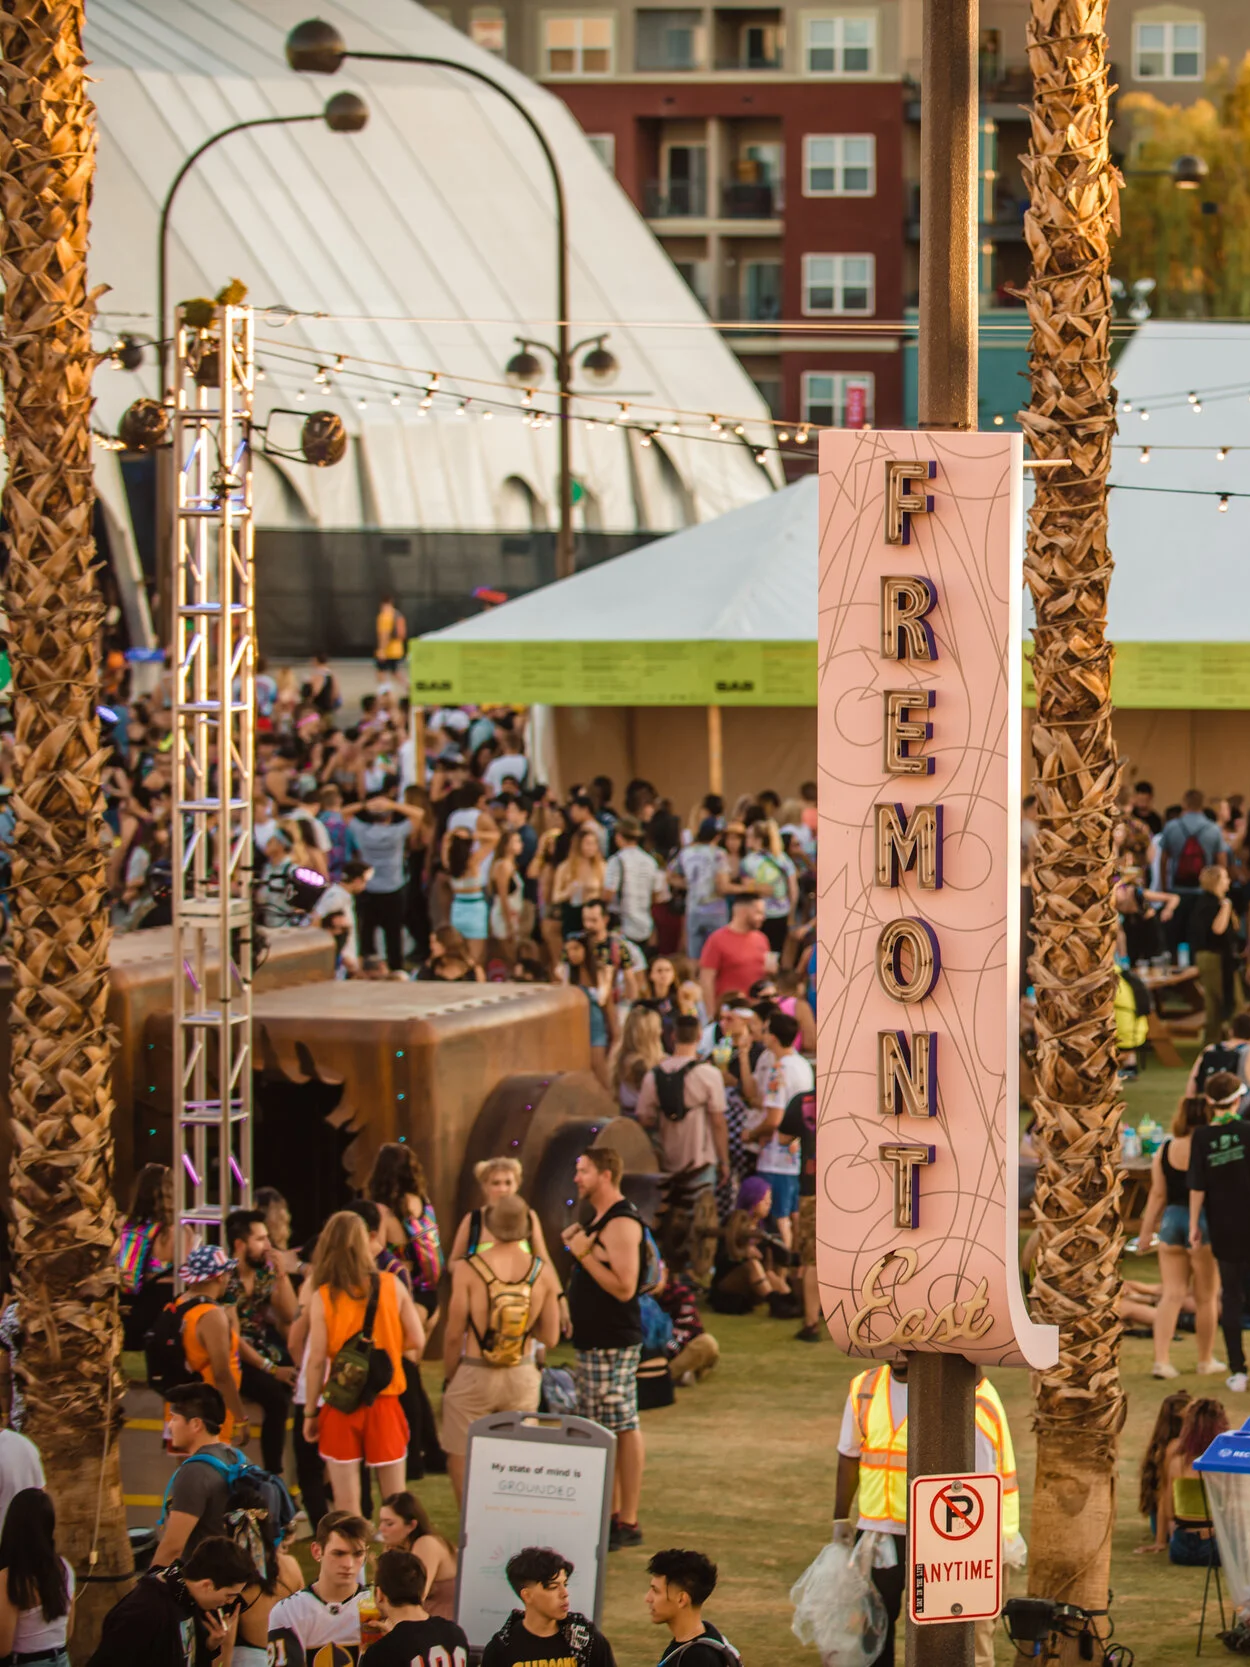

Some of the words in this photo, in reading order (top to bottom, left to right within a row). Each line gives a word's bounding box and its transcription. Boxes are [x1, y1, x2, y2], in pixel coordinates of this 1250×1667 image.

[873, 460, 944, 1230] FREMONT
[848, 1246, 995, 1350] East
[491, 1462, 506, 1472] My
[508, 1465, 531, 1474] state
[534, 1466, 544, 1474] of
[546, 1468, 571, 1477] mind
[573, 1470, 582, 1478] is
[498, 1479, 577, 1498] GROUNDED
[916, 1564, 924, 1577] LIFE
